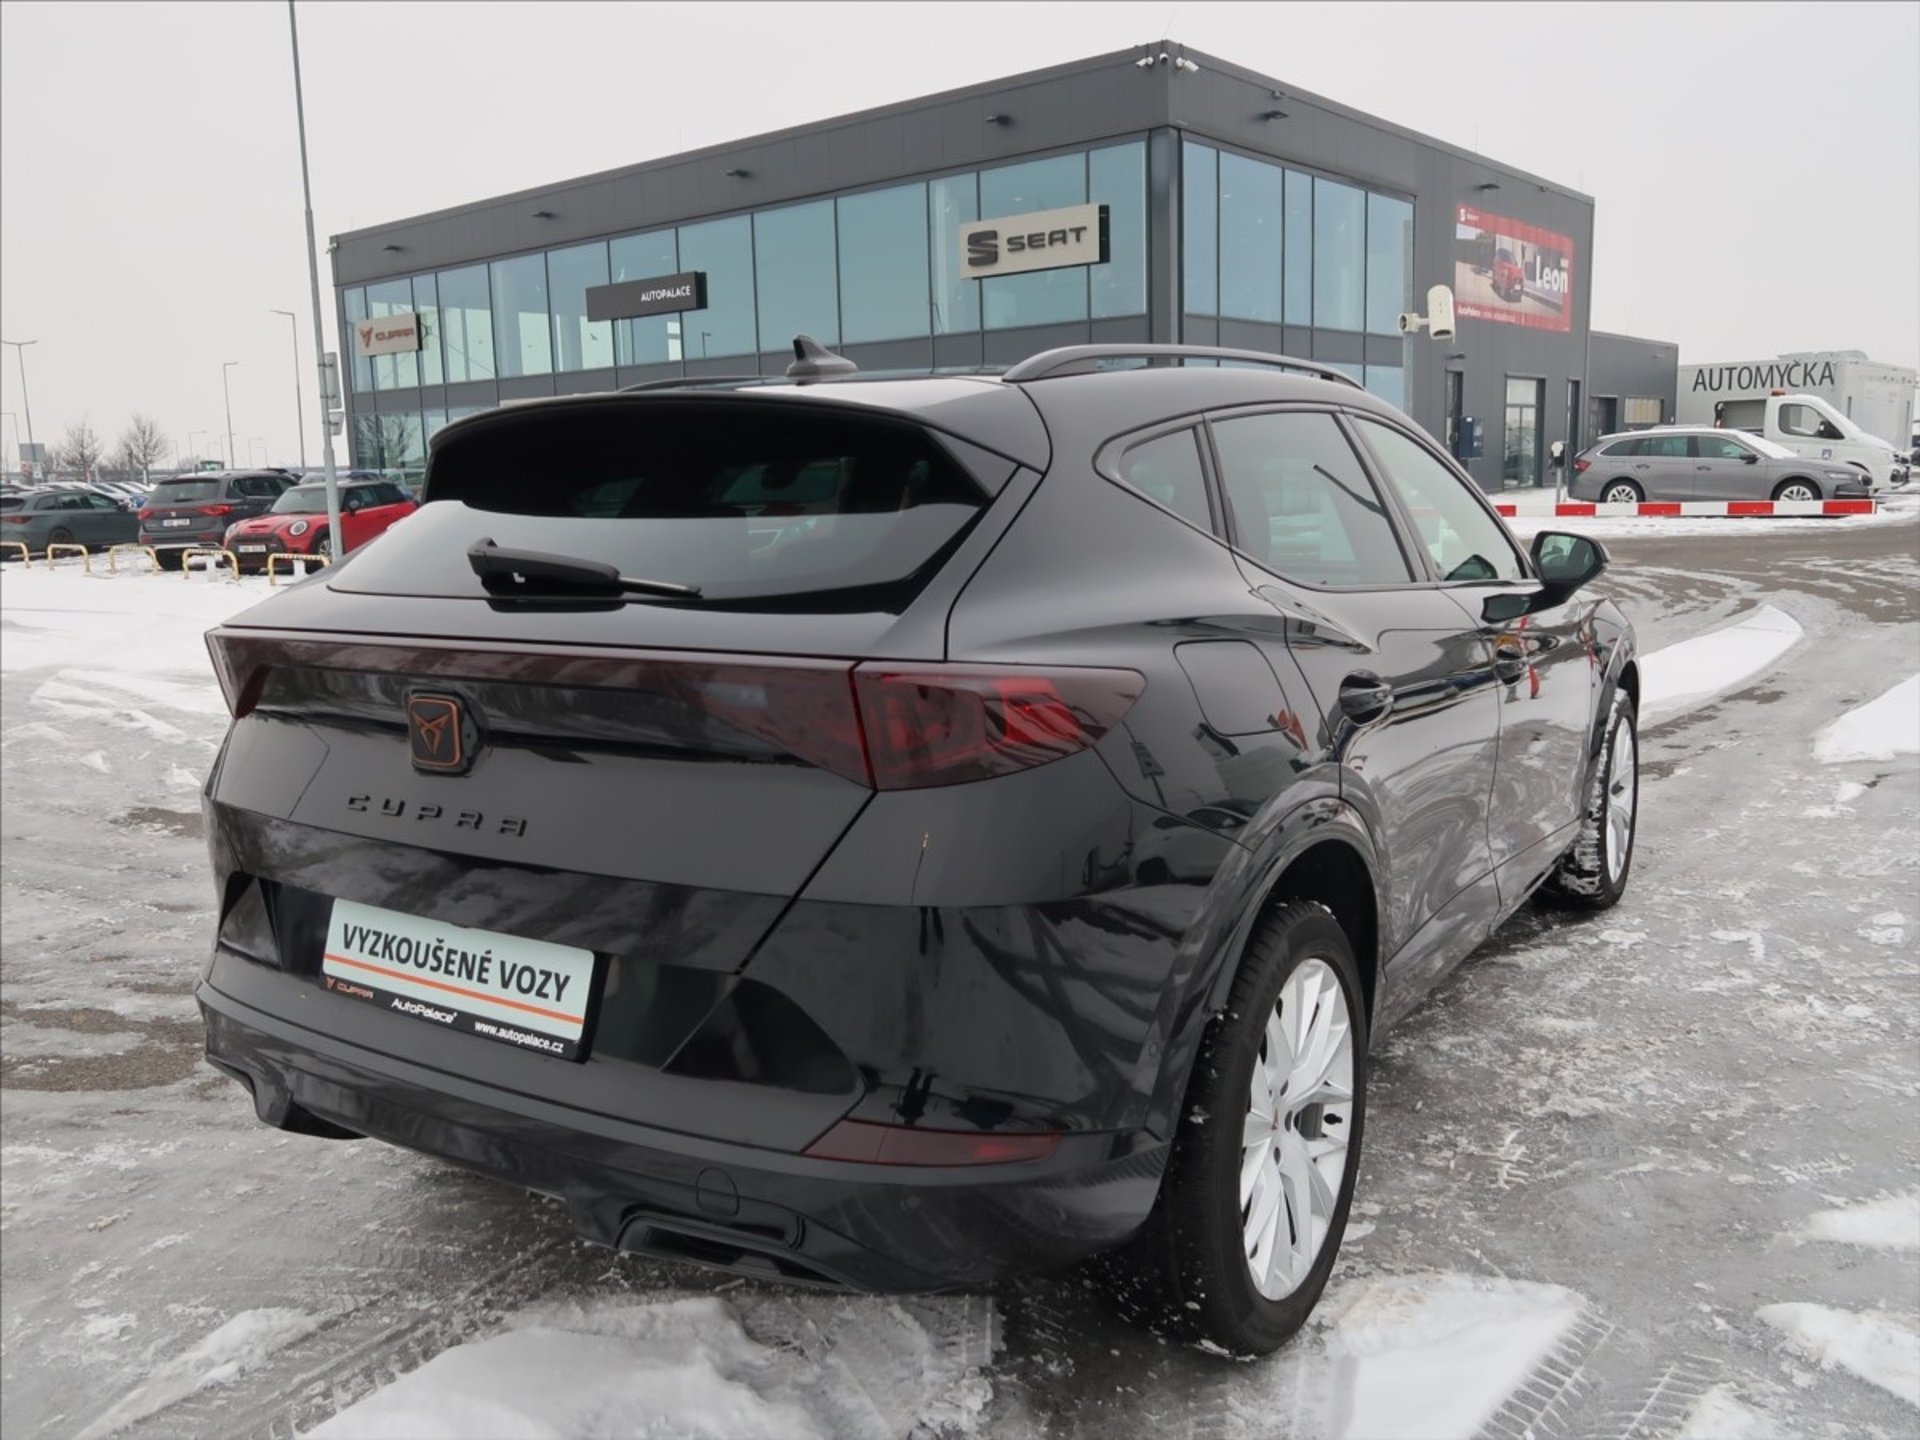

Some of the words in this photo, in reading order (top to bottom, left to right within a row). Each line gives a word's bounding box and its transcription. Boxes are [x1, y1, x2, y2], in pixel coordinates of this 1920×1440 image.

[1006, 226, 1087, 252] SEAT
[641, 284, 691, 302] AUTOPALACE
[1692, 360, 1835, 393] AUTOMYČKA
[348, 795, 528, 838] CUPRA
[343, 923, 492, 985] VYZKOUŠENÉ
[499, 960, 571, 1003] VOZY
[474, 1021, 564, 1054] www.autopalace.cz
